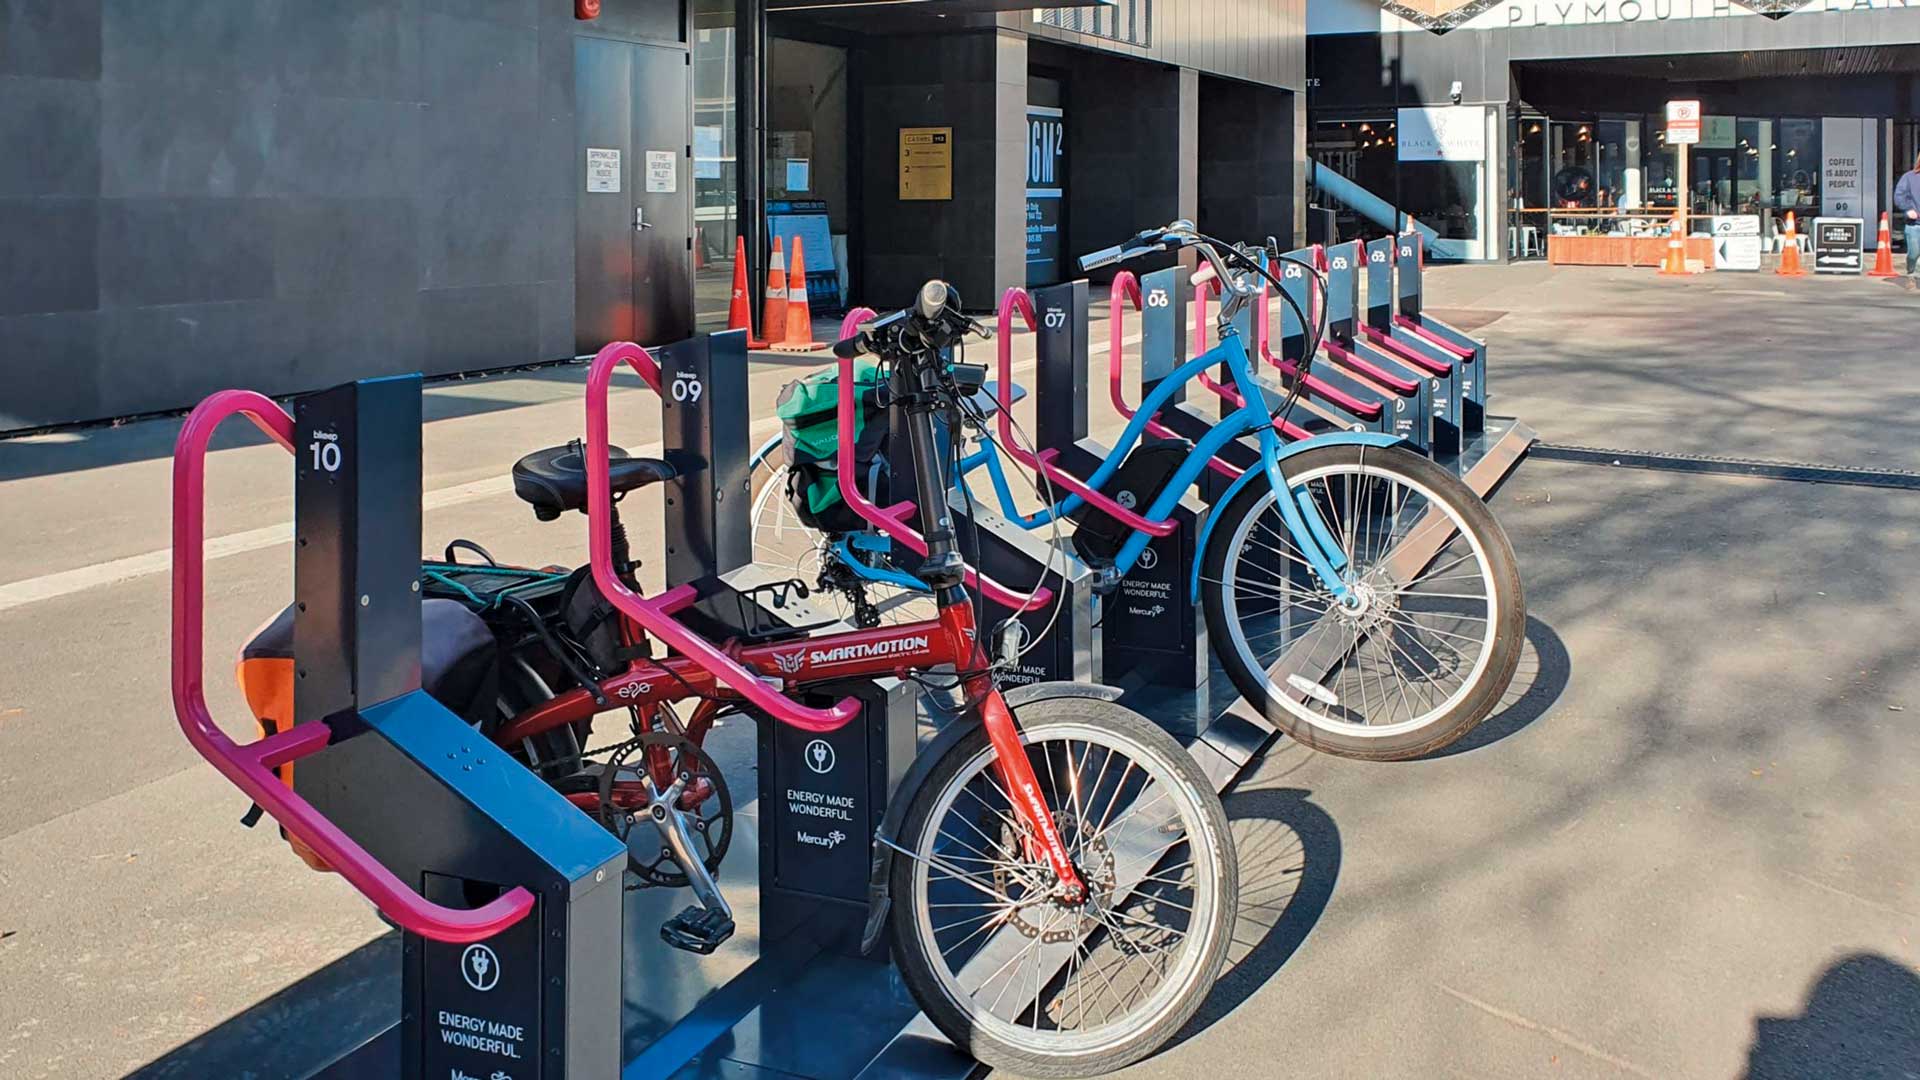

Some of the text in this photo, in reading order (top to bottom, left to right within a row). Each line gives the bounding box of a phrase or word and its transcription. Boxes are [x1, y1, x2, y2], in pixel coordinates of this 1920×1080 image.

[1508, 0, 1731, 28] PLYMOUTH
[1828, 158, 1856, 167] COFFEE
[1825, 169, 1858, 177] IS ABOUT
[1828, 180, 1856, 189] PEOPLE
[1371, 253, 1386, 263] 02
[1400, 249, 1413, 257] 01
[1332, 260, 1348, 270] 03
[1285, 268, 1302, 279] 04
[1147, 294, 1169, 307] 06
[1044, 313, 1066, 328] 07
[671, 379, 702, 402] 09
[309, 441, 341, 472] 10
[1122, 579, 1172, 591] ENERGY MADE
[1128, 606, 1156, 618] Mercury
[810, 635, 928, 664] SMARTMOTION
[1022, 665, 1046, 676] MADE
[787, 788, 855, 809] ENERGY MADE
[797, 831, 834, 849] Mercury
[438, 1010, 524, 1041] ENERGY MADE
[441, 1028, 521, 1059] WONDERFUL.
